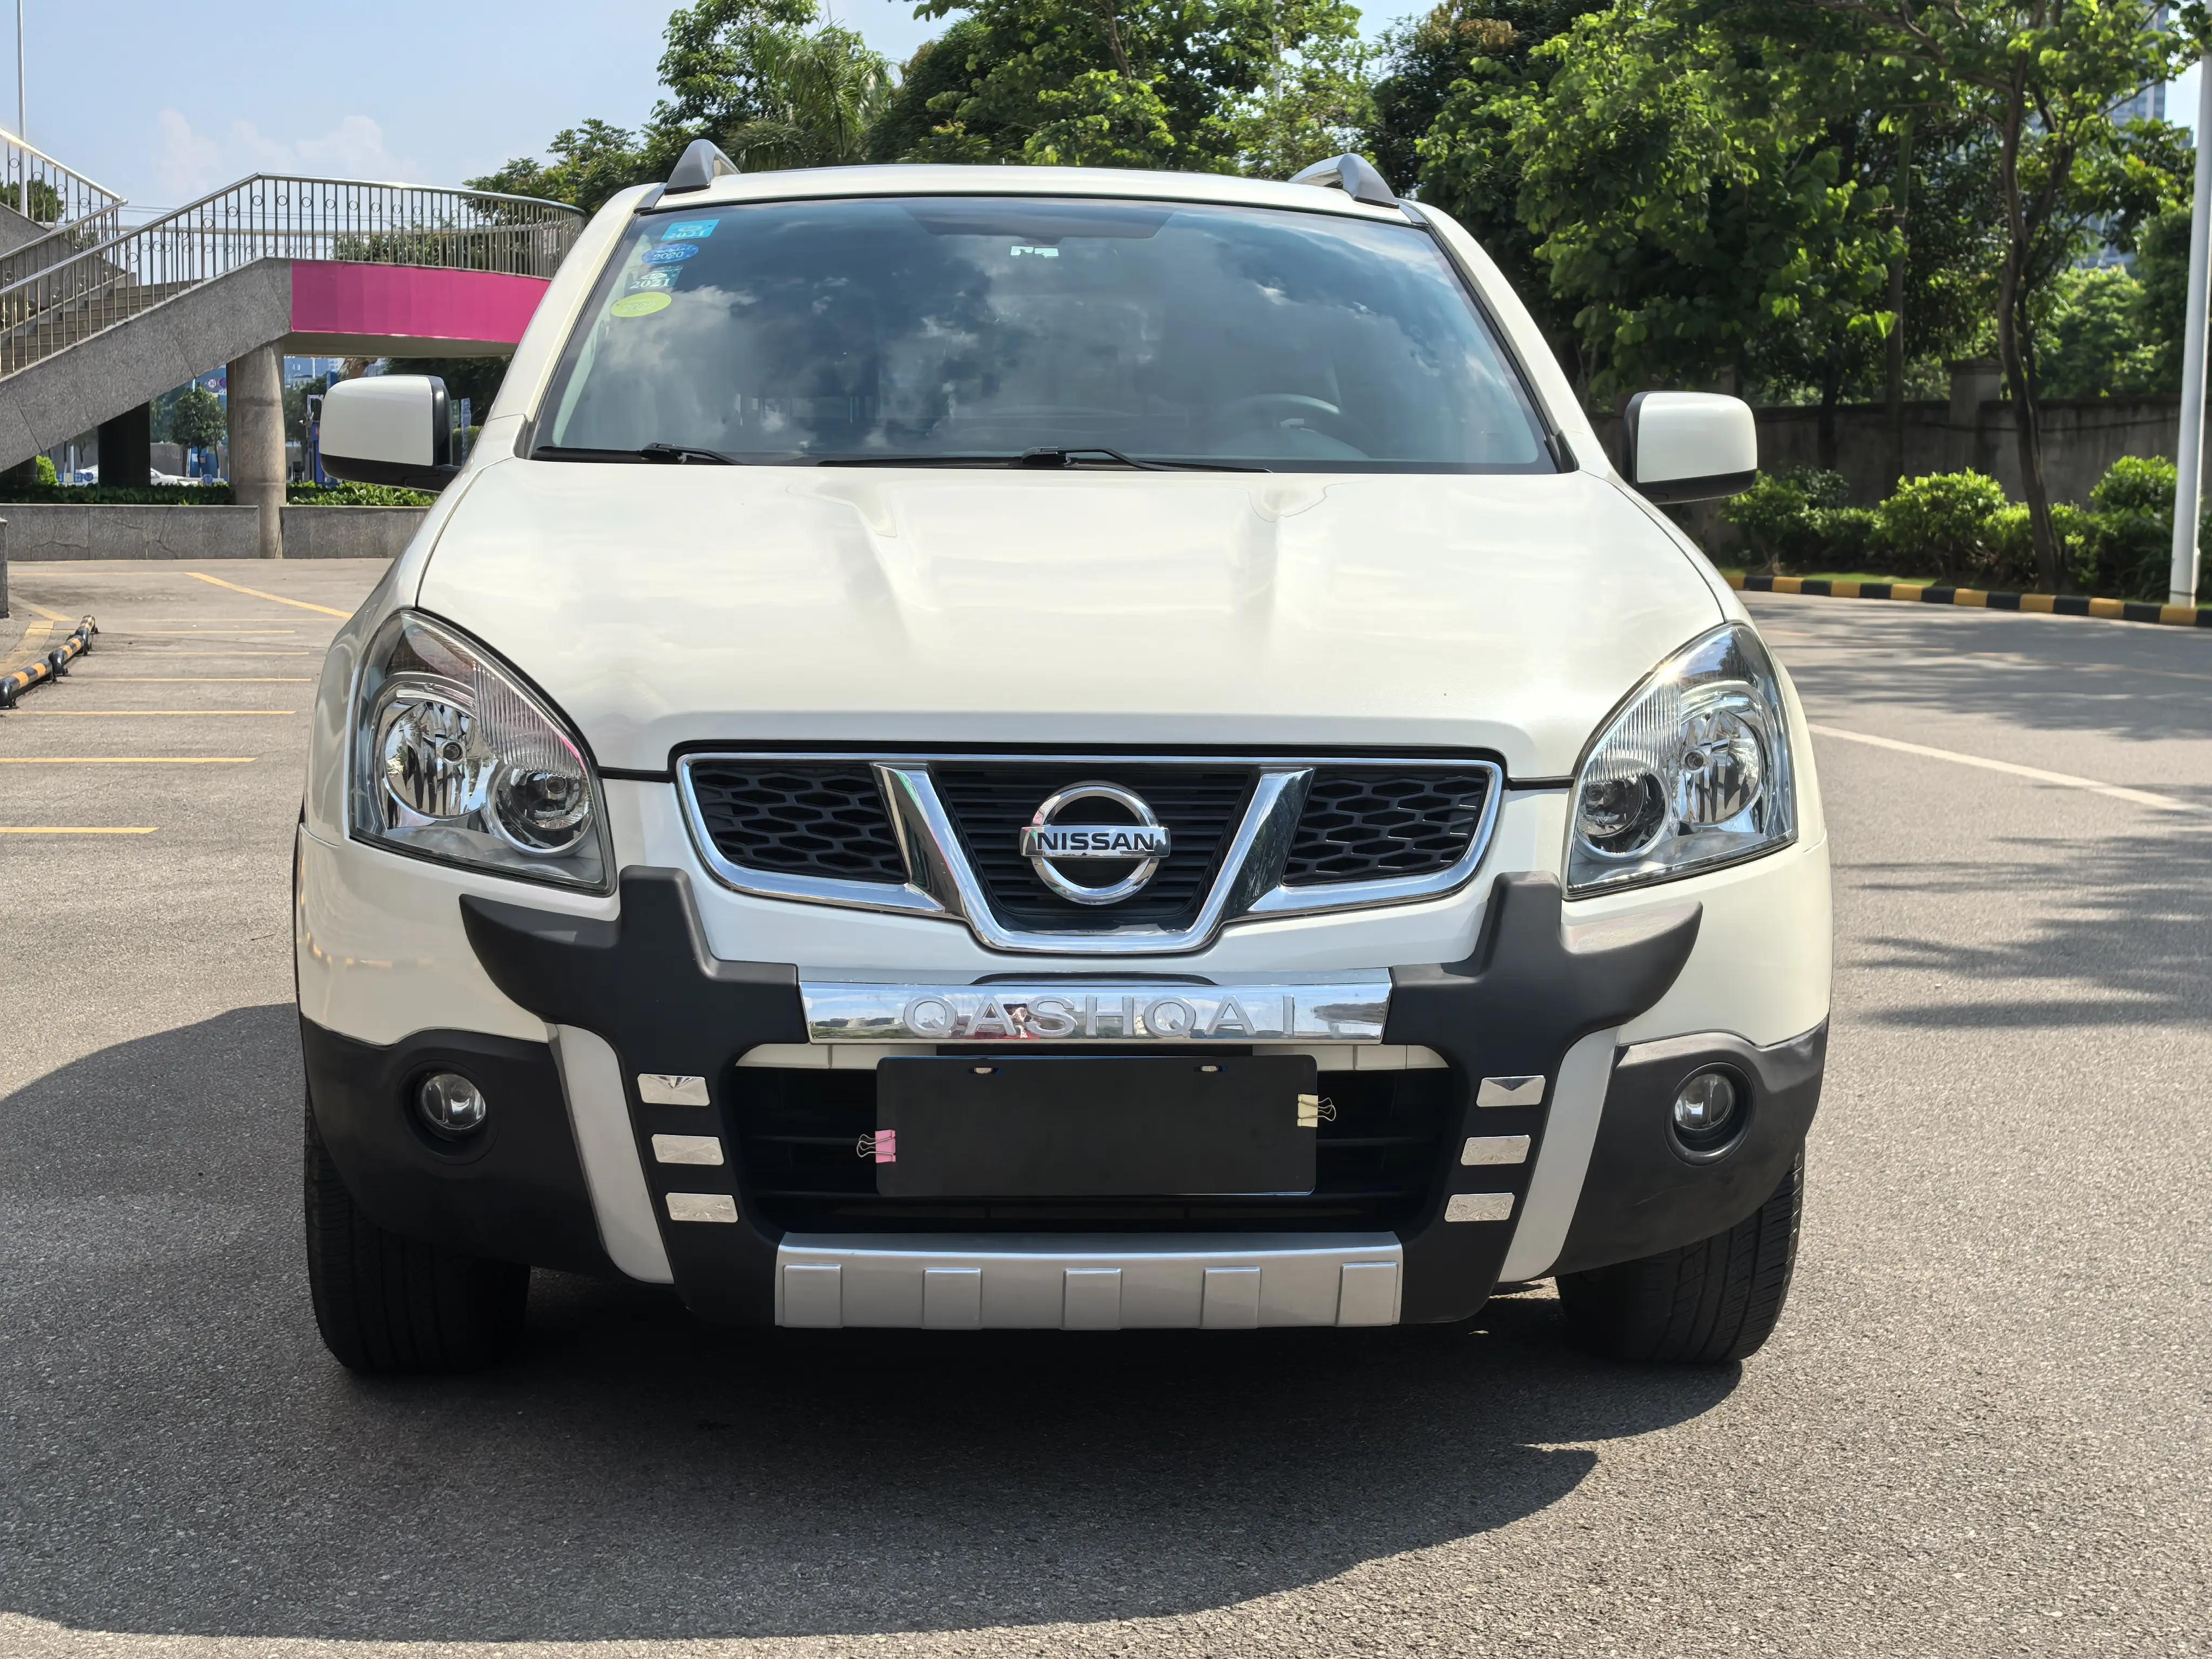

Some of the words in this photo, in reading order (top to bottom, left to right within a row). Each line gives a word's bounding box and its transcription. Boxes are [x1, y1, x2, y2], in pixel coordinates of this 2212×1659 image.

[651, 251, 684, 260] 2020
[629, 278, 670, 289] 2021
[1036, 832, 1154, 851] NISSAN
[902, 994, 1294, 1038] QASHQAI
